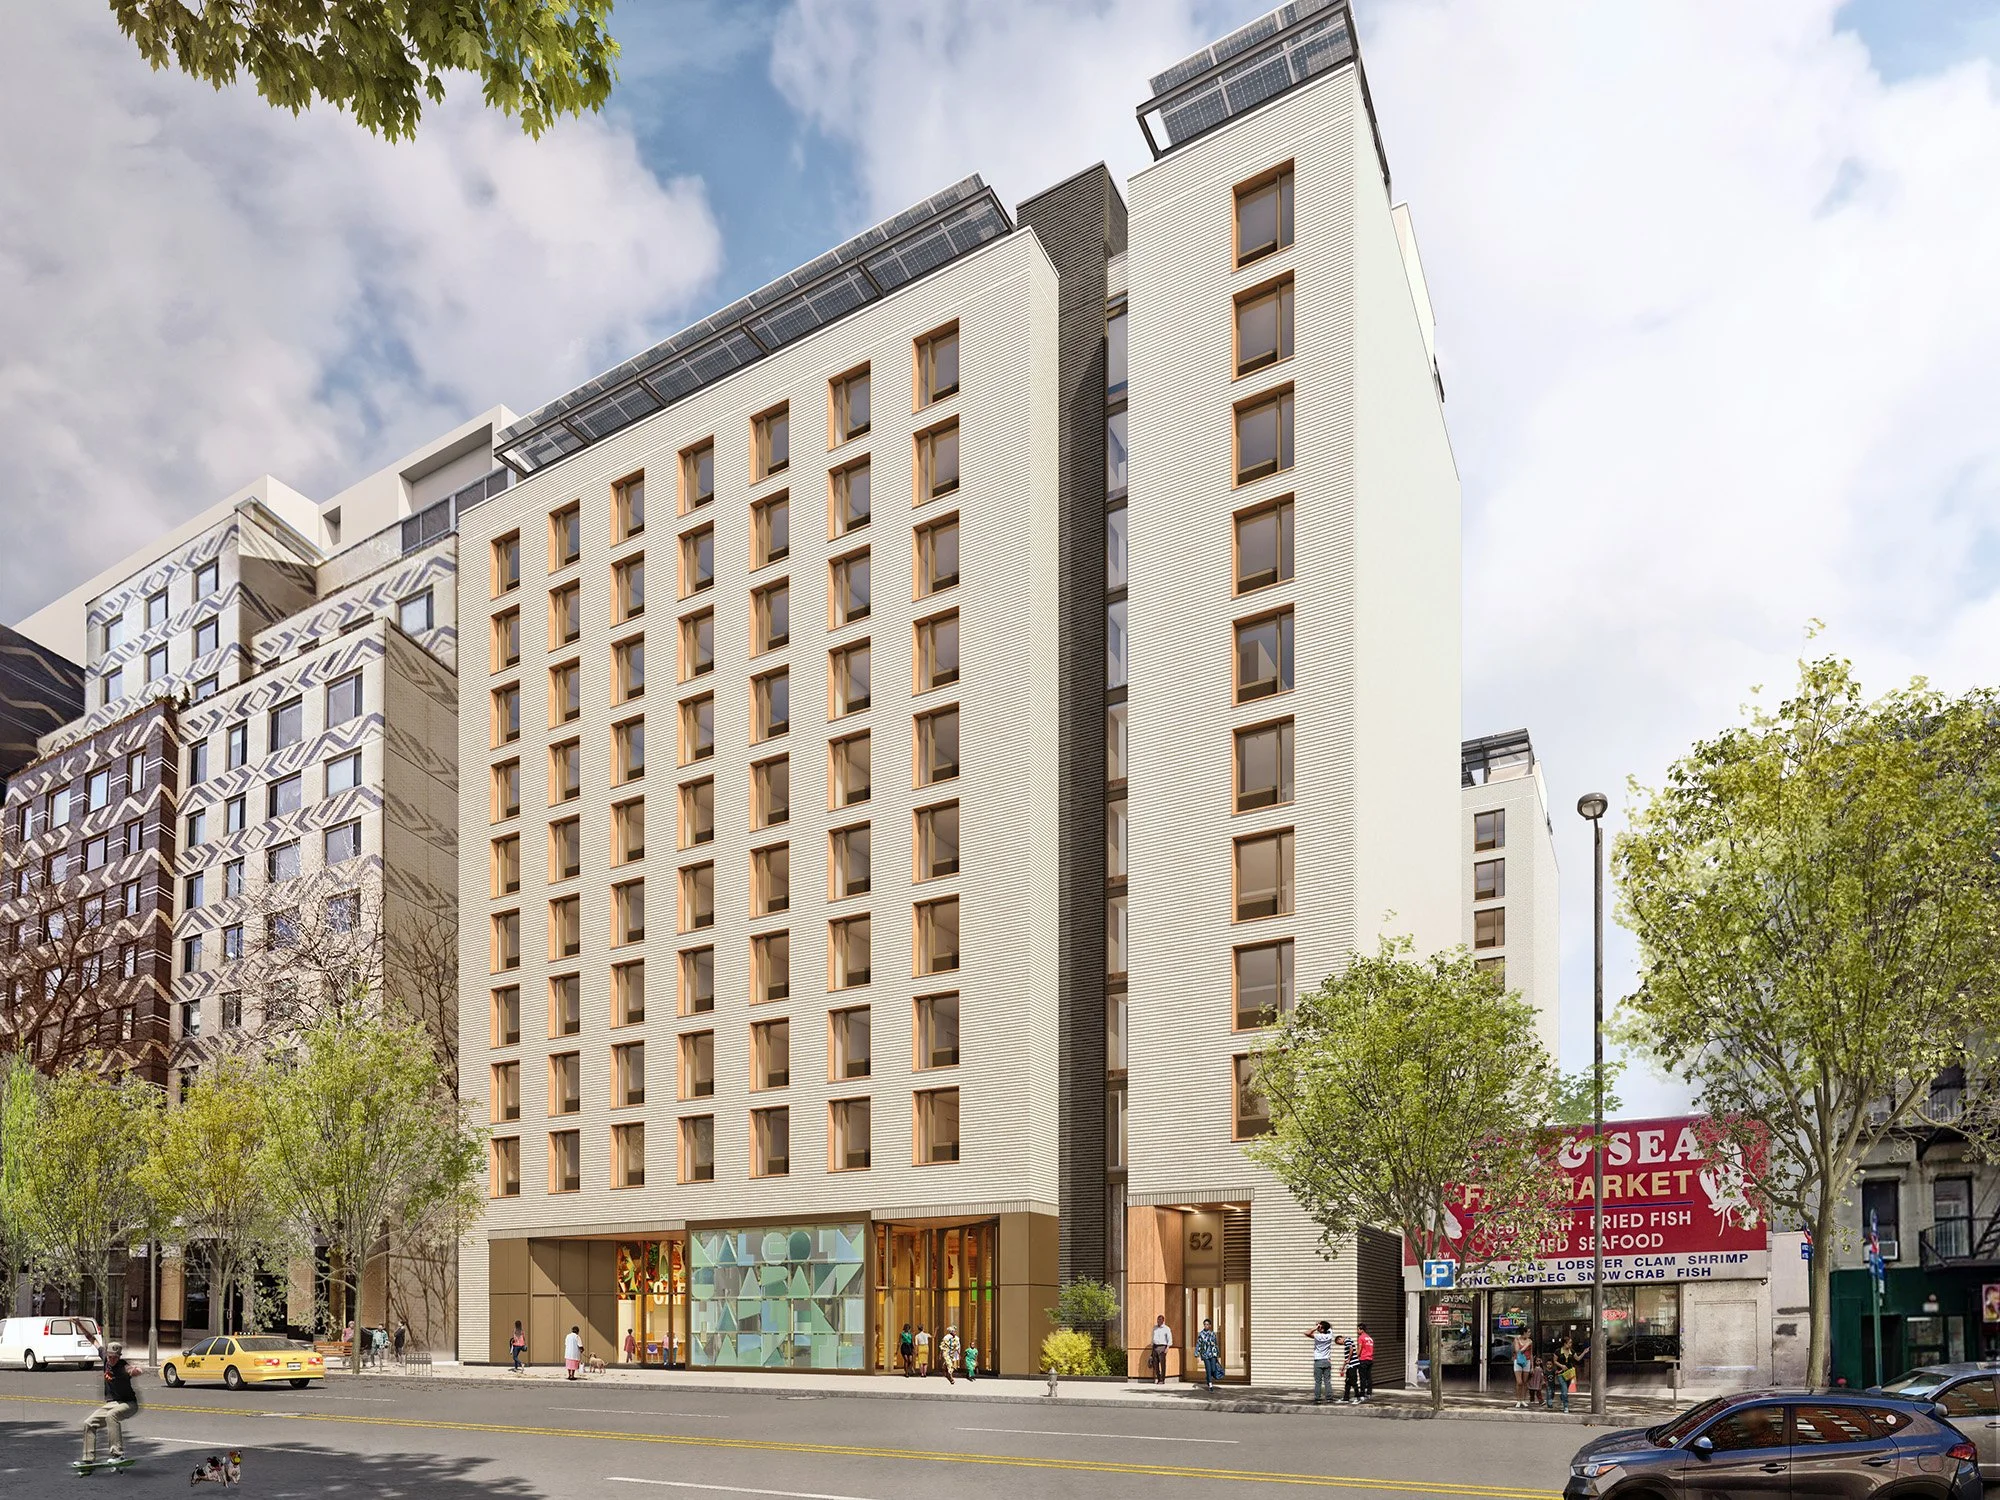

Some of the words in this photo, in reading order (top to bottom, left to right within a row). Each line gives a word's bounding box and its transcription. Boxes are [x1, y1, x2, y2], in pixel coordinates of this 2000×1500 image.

[1608, 1127, 1706, 1166] SEA
[1651, 1211, 1692, 1227] FISH
[1190, 1232, 1212, 1250] 52
[1557, 1258, 1623, 1271] LOBSER
[1634, 1255, 1677, 1268] CLAM
[1687, 1252, 1749, 1266] SHRIMP
[1432, 1264, 1449, 1286] P
[1539, 1272, 1566, 1283] LEG
[1624, 1270, 1665, 1281] CRAB
[1677, 1267, 1711, 1278] FISH
